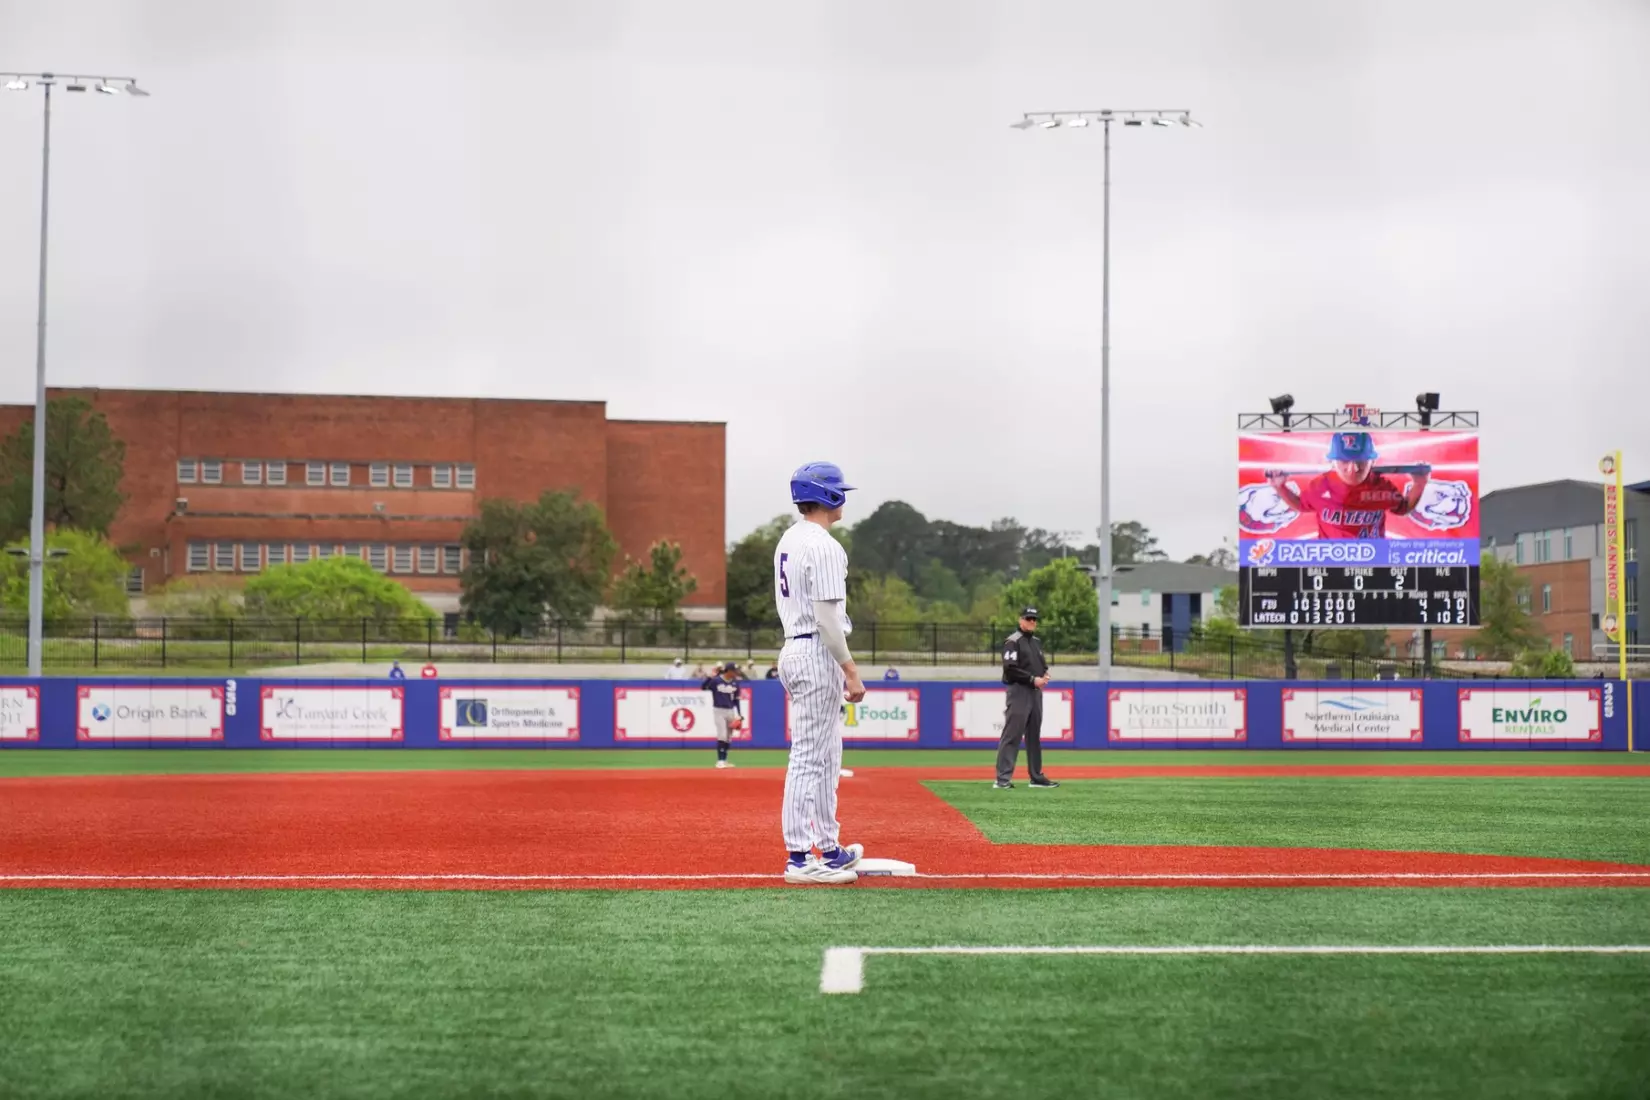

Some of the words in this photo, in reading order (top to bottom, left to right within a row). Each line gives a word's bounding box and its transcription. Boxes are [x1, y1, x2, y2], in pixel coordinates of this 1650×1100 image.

[1278, 543, 1375, 562] PAFFORD
[1388, 551, 1401, 565] is
[1405, 549, 1467, 564] critical.
[779, 552, 790, 598] 5
[1344, 567, 1373, 577] STRIKE
[1313, 575, 1323, 590] 0
[1354, 575, 1364, 590] 0
[1395, 575, 1405, 590] 2
[1294, 599, 1299, 611] 1
[1301, 599, 1310, 611] 0
[1313, 599, 1320, 611] 3
[1325, 599, 1333, 611] 0
[1336, 599, 1344, 611] 0
[1347, 599, 1355, 611] 0
[1419, 599, 1428, 611] 4
[1444, 599, 1451, 611] 7
[1456, 599, 1465, 611] 0
[1290, 611, 1299, 624] 0
[1305, 611, 1310, 624] 1
[1313, 611, 1320, 624] 3
[1325, 611, 1333, 624] 2
[1336, 611, 1344, 624] 0
[1351, 611, 1355, 624] 1
[1420, 611, 1428, 624] 7
[1437, 611, 1451, 624] 10
[1456, 611, 1465, 624] 2
[1003, 651, 1017, 661] 44
[116, 705, 165, 723] Origin
[169, 705, 207, 719] Bank
[547, 707, 556, 716] &
[859, 706, 908, 721] Foods
[1128, 703, 1169, 715] Ivan
[1172, 700, 1226, 716] Smith
[1492, 707, 1568, 724] ENVIRO
[1305, 711, 1351, 721] Northern
[1354, 711, 1400, 721] Louisiana
[491, 719, 520, 731] Sports
[522, 719, 563, 728] Medicine
[1314, 723, 1354, 733] Medical
[1356, 723, 1391, 733] Center
[1505, 724, 1556, 735] RENTALS
